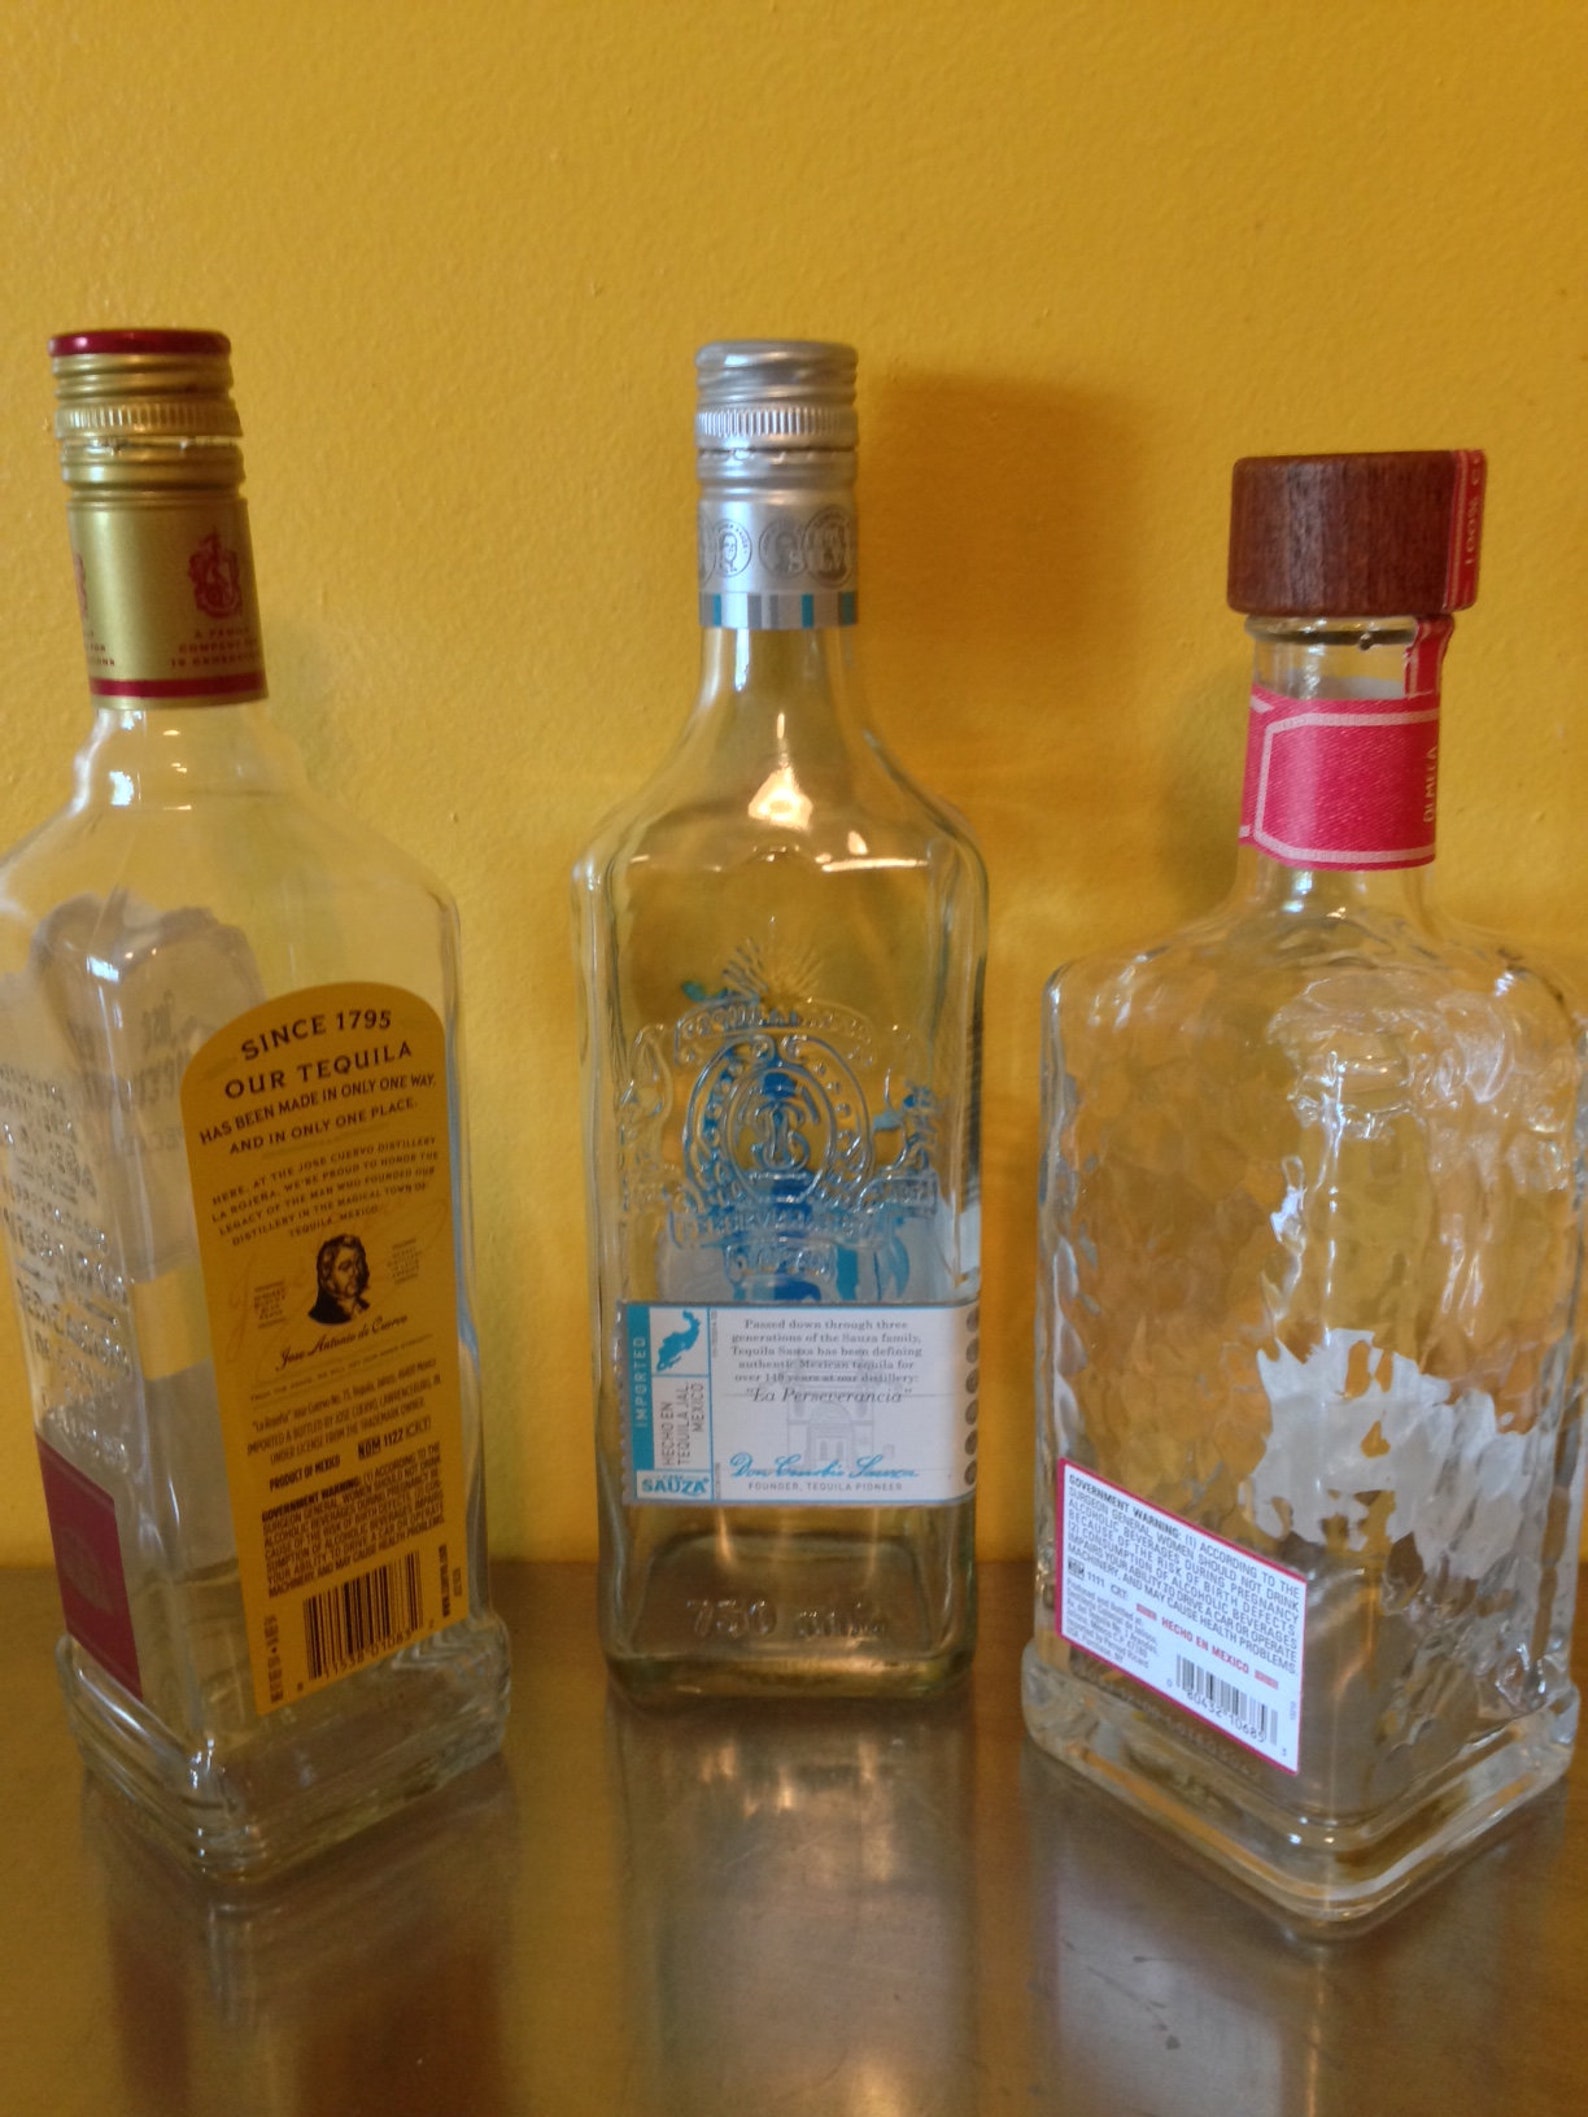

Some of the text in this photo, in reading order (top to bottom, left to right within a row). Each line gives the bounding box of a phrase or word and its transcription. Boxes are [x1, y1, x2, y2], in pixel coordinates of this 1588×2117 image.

[241, 1009, 391, 1061] SINCE 1795
[225, 1040, 412, 1099] OUR TEQUILA
[199, 1121, 232, 1145] HAS
[235, 1104, 275, 1131] BEEN
[278, 1091, 318, 1115] MADE
[322, 1086, 337, 1102] IN
[341, 1079, 376, 1098] ONLY
[379, 1075, 407, 1091] ONE
[230, 1131, 264, 1154] AND
[269, 1130, 286, 1145] IN
[291, 1119, 330, 1139] ONLY
[335, 1108, 367, 1129] ONE
[731, 1334, 805, 1345] generations
[805, 1333, 818, 1343] of
[820, 1333, 839, 1343] the
[731, 1346, 776, 1357] Tequila
[817, 1346, 838, 1356] has
[840, 1347, 870, 1356] been
[872, 1346, 922, 1358] defining
[789, 1319, 822, 1329] down
[876, 1319, 908, 1329] three
[633, 1337, 647, 1428] IMPORTED
[799, 1360, 849, 1370] Mexican
[897, 1360, 915, 1370] for
[660, 1402, 674, 1420] EN
[641, 1475, 707, 1496] SAUZA
[807, 1481, 852, 1491] TEQUILA
[855, 1481, 903, 1491] PIONEER
[1068, 1507, 1112, 1541] BECAUSE
[1117, 1533, 1129, 1549] OF
[1134, 1543, 1153, 1562] THE
[1157, 1554, 1181, 1577] RISK
[1185, 1569, 1199, 1587] OF
[1203, 1579, 1237, 1607] BIRTH
[1068, 1496, 1298, 1627] ALCOHOLIC BEVERAGES DURING PREGNANCY
[1069, 1472, 1129, 1513] GOVERNMENT
[1199, 1539, 1256, 1580] ACCORDING
[1261, 1570, 1275, 1588] TO
[1279, 1578, 1299, 1600] THE
[1082, 1526, 1152, 1573] CONSUMPTION
[1155, 1565, 1168, 1581] OF
[1172, 1575, 1228, 1614] ALCOHOLIC
[1232, 1606, 1297, 1651] BEVERAGES
[1156, 1531, 1194, 1560] WOMEN
[1198, 1552, 1236, 1582] SHOULD
[1240, 1574, 1261, 1595] NOT
[1266, 1586, 1299, 1613] DRINK
[1122, 1571, 1142, 1591] AND
[1144, 1583, 1165, 1604] MAY
[1167, 1596, 1198, 1622] CAUSE
[1199, 1614, 1237, 1643] HEALTH
[1128, 1562, 1161, 1590] ABILITY
[1162, 1581, 1175, 1597] TO
[1176, 1589, 1203, 1613] DRIVE
[1204, 1604, 1212, 1618] A
[1213, 1609, 1233, 1630] CAR
[1235, 1620, 1249, 1638] OR
[1251, 1629, 1296, 1664] OPERATE
[1161, 1615, 1192, 1643] HECHO
[1195, 1634, 1208, 1651] EN
[1211, 1643, 1249, 1675] MEXICO
